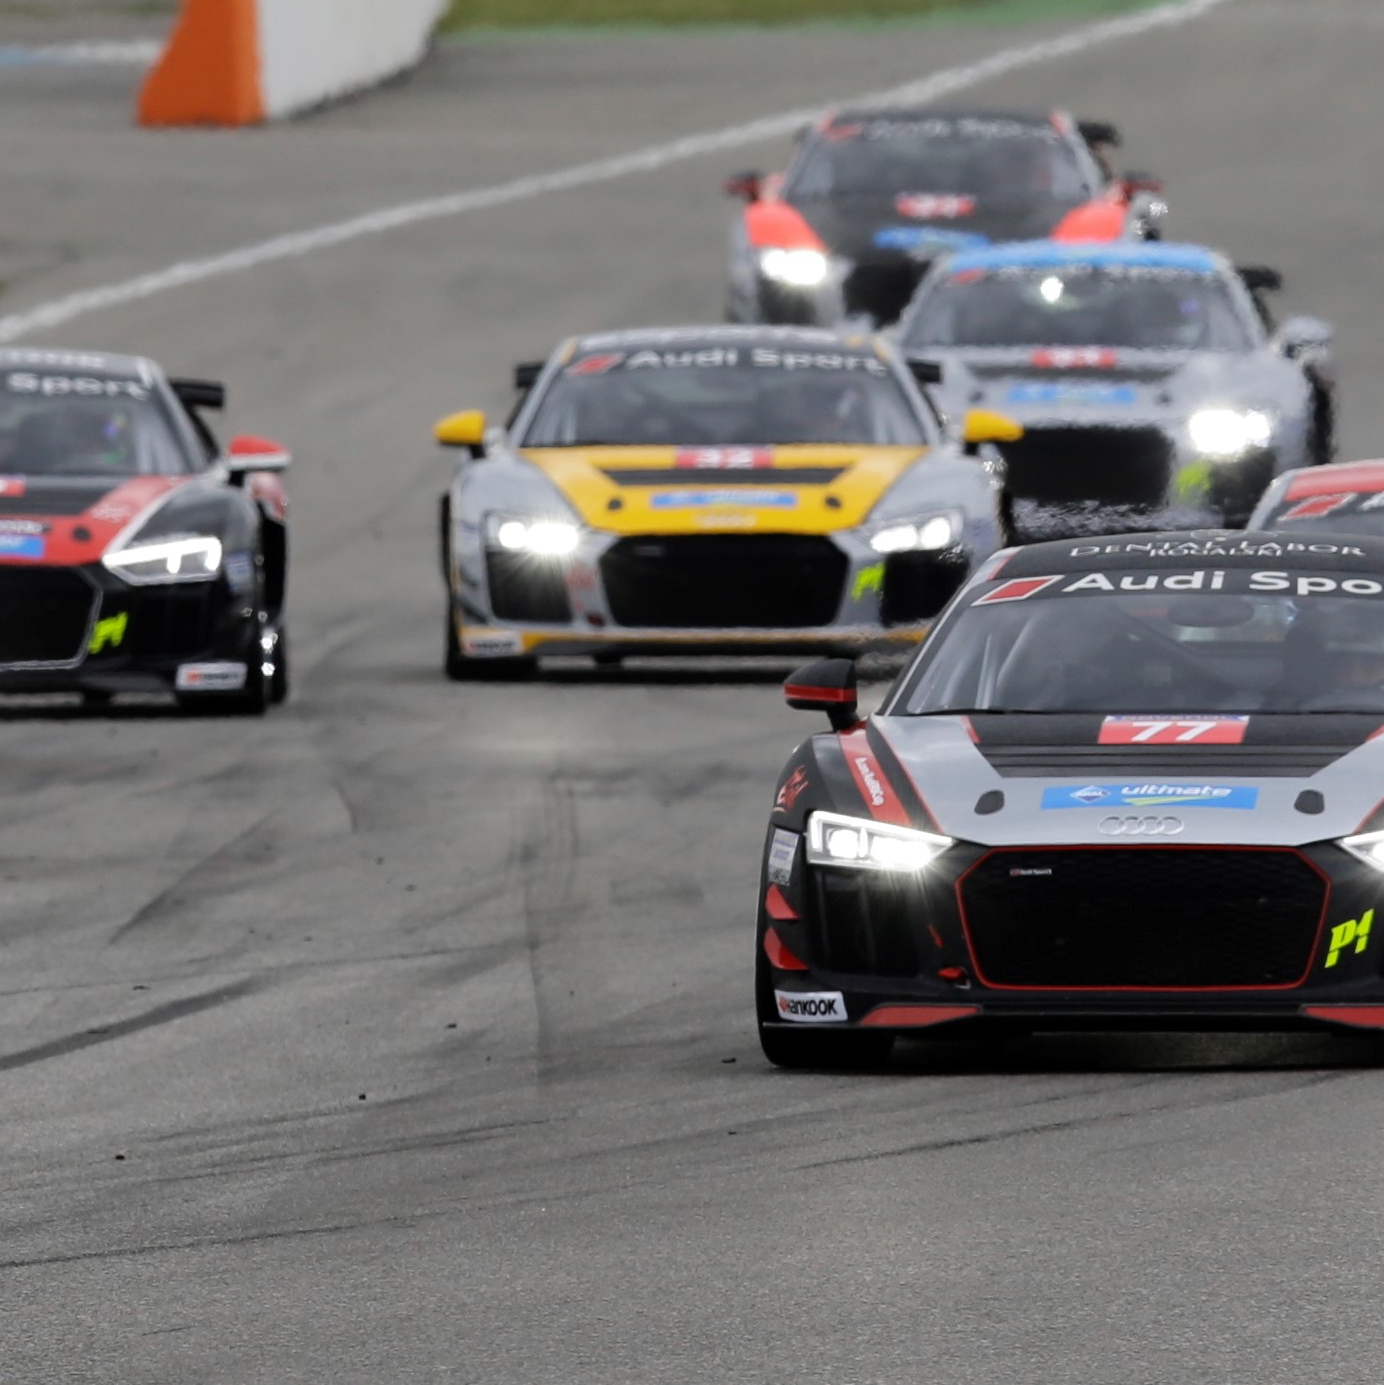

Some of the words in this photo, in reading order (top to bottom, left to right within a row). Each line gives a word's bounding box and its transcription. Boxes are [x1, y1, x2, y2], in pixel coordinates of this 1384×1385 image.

[626, 347, 737, 370] Audi
[752, 348, 887, 376] Sport
[6, 370, 151, 401] Sport
[1062, 570, 1226, 592] Audi
[1131, 721, 1218, 742] 77
[1120, 784, 1233, 796] ultimate
[1324, 908, 1375, 968] P1
